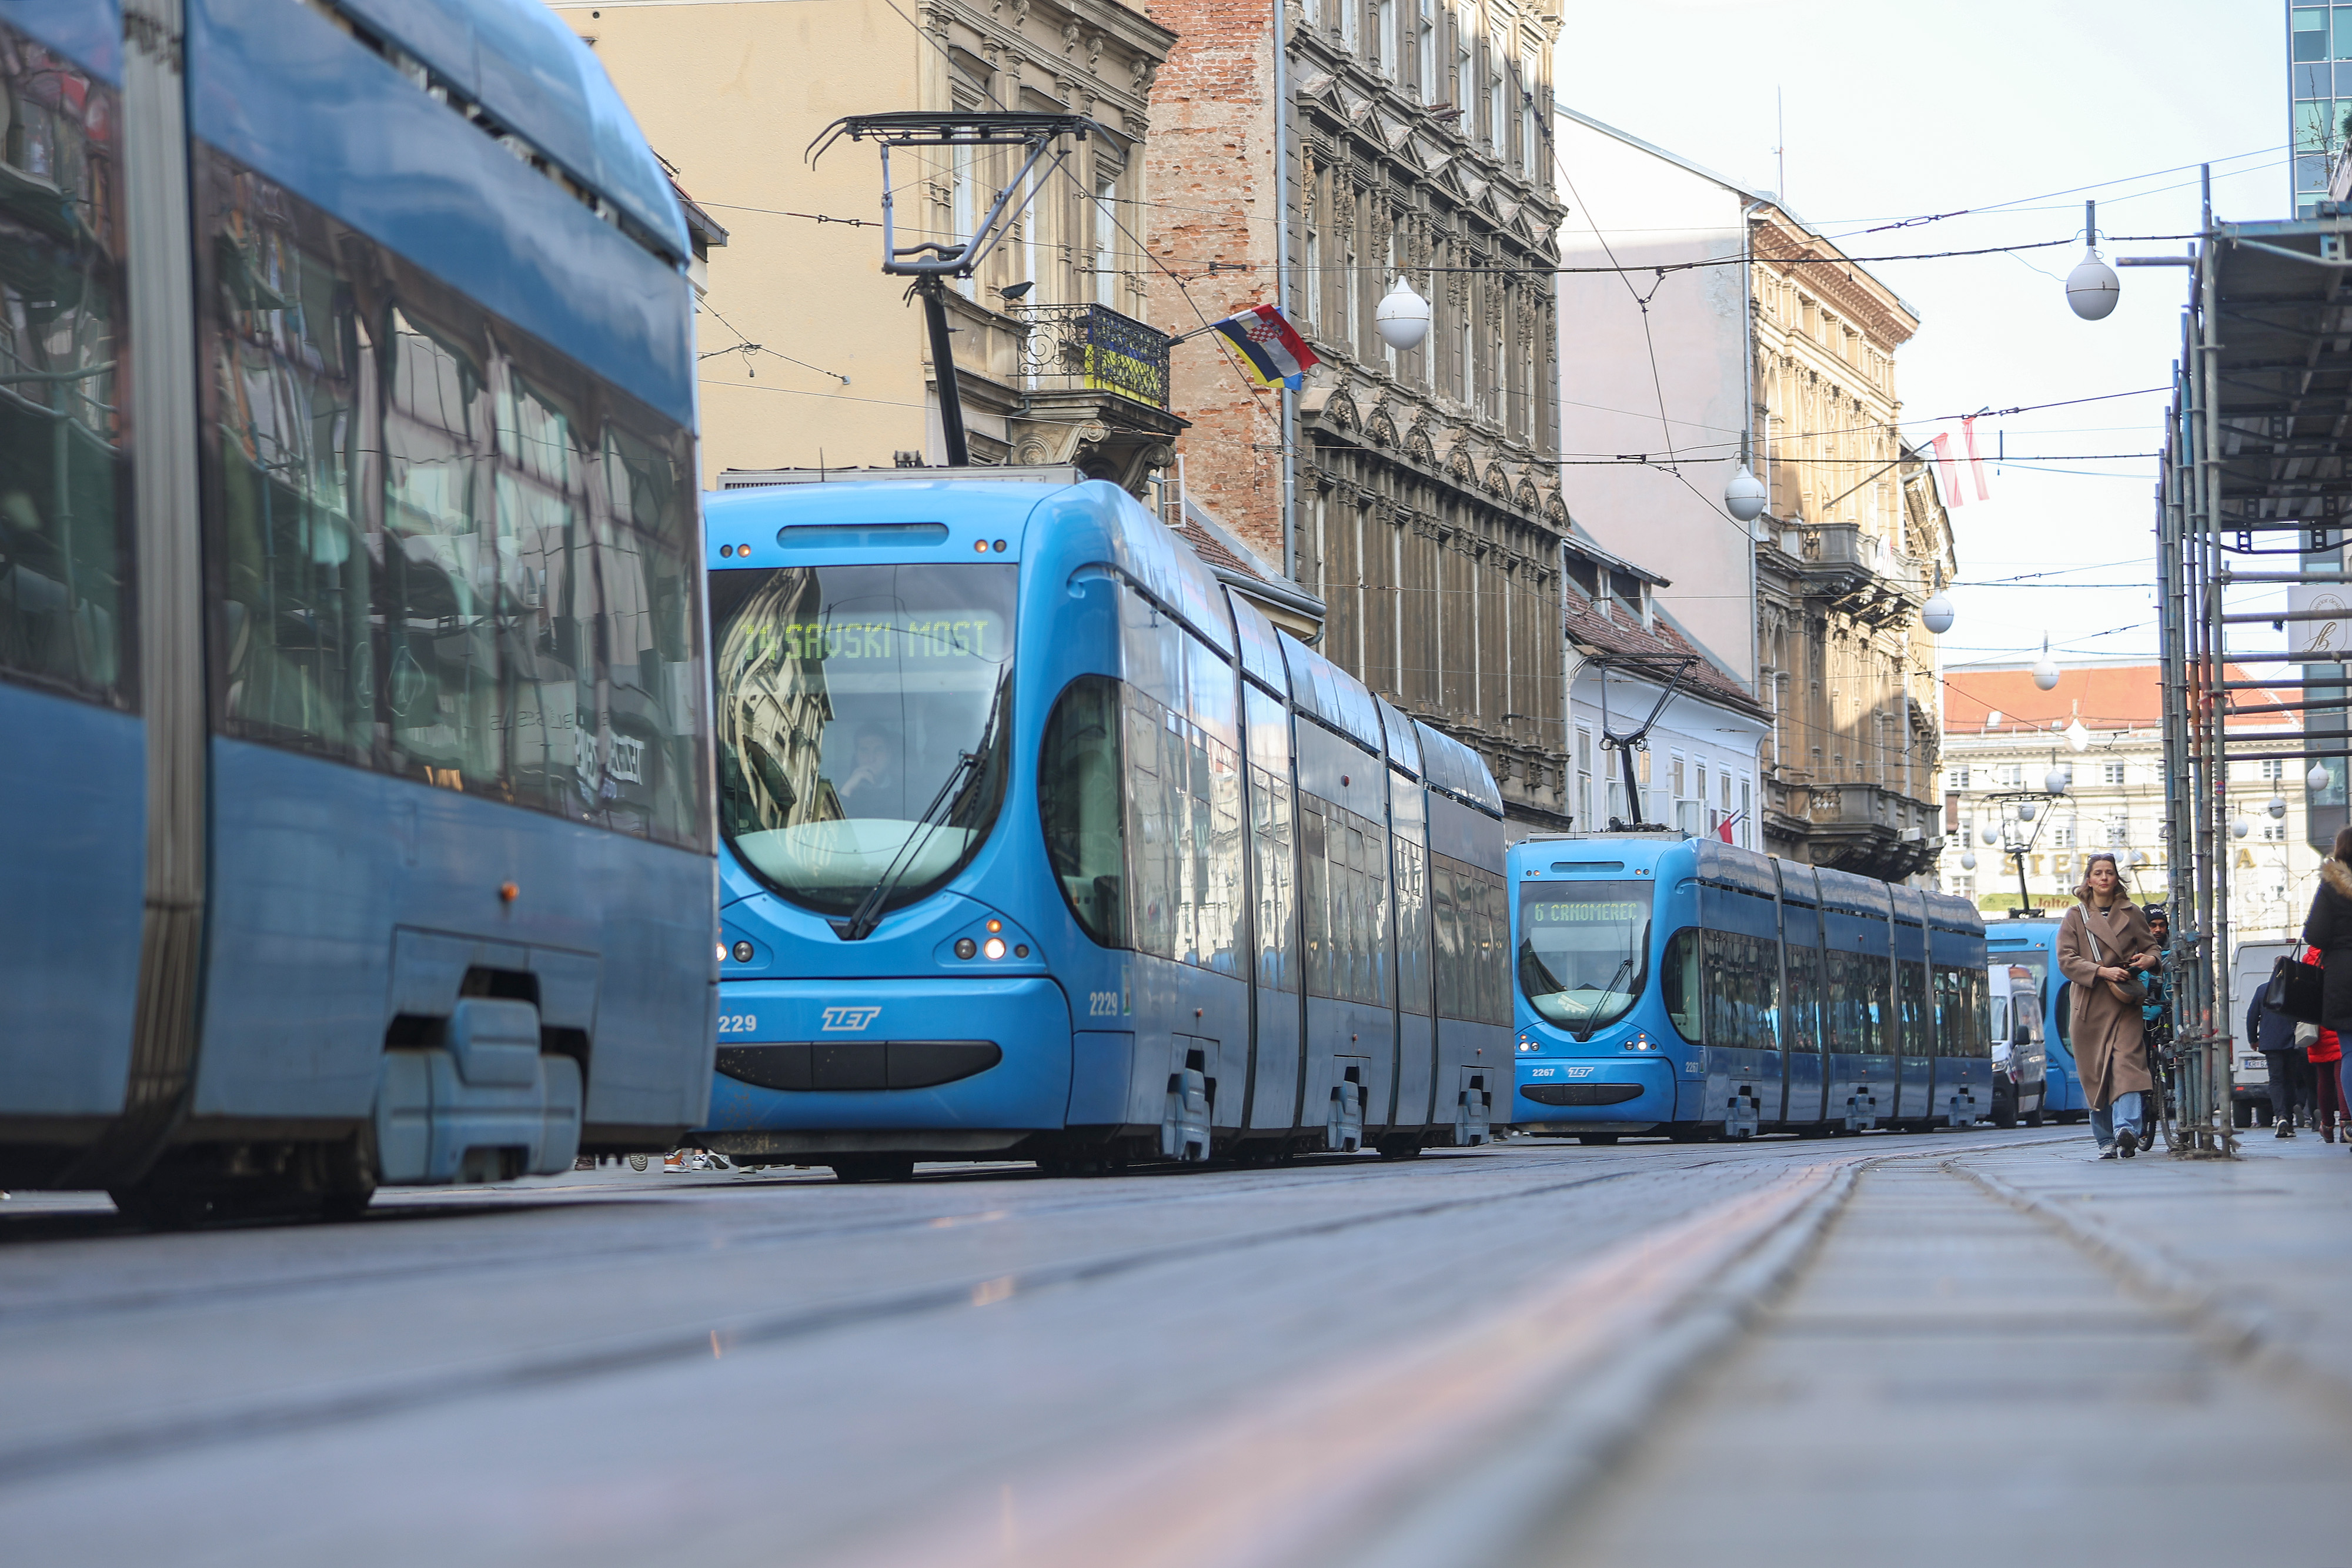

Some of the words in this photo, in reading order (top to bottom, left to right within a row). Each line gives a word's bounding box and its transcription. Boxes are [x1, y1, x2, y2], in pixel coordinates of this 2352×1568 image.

[786, 622, 891, 660] SAVSKI
[909, 620, 988, 657] MOST
[2034, 897, 2069, 908] Jalta
[1535, 904, 1545, 921] 6
[1090, 991, 1117, 1017] 2229
[718, 1014, 757, 1033] 229
[821, 1006, 882, 1031] ZET
[1532, 1068, 1555, 1077] 2267
[1568, 1066, 1595, 1078] ZET
[1685, 1061, 1699, 1073] 2267
